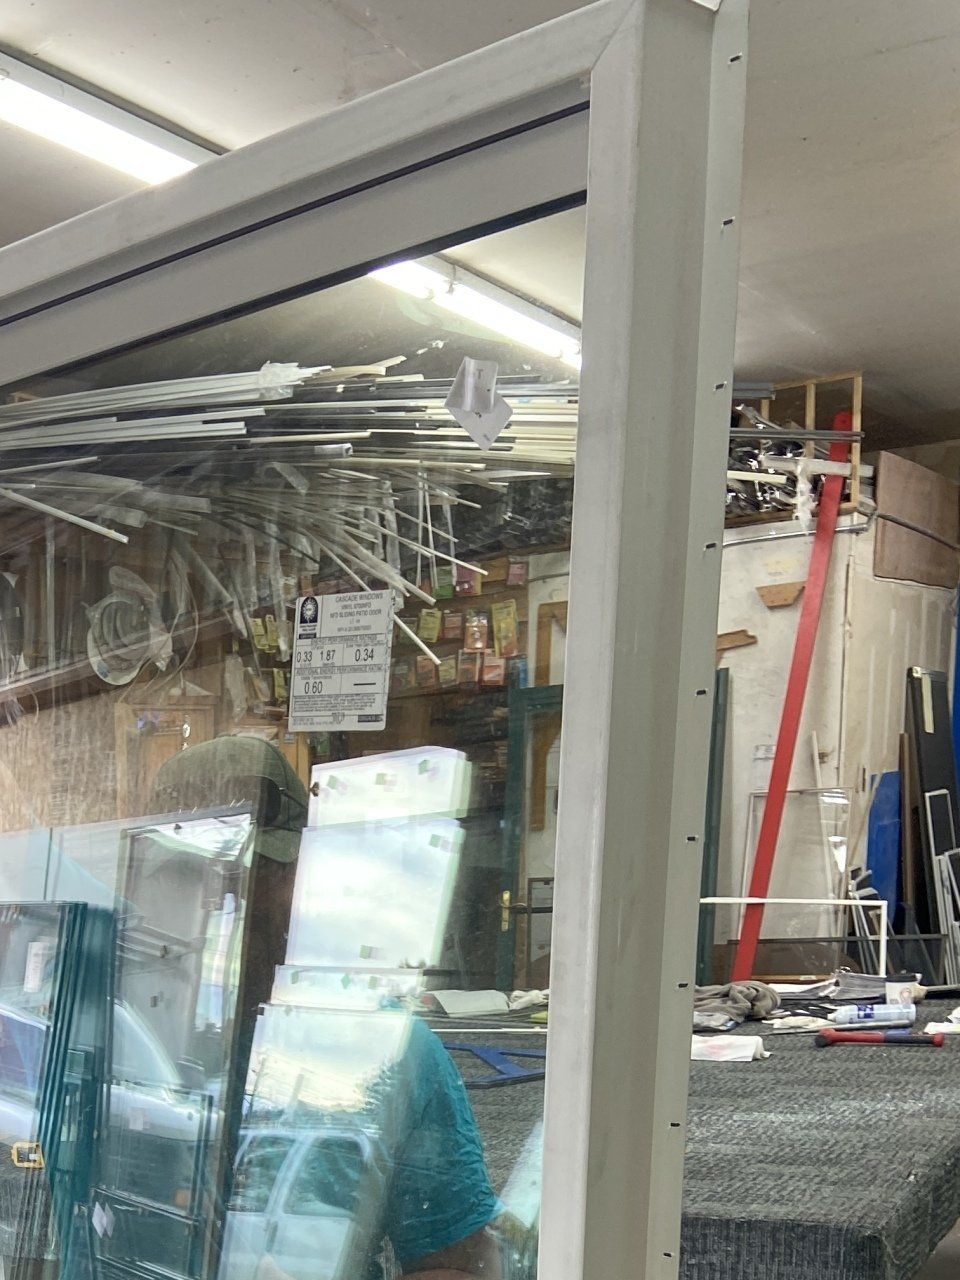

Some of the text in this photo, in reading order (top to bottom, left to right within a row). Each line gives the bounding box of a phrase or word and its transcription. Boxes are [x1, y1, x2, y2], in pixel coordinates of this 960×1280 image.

[296, 649, 336, 663] 0.33 1.87
[354, 648, 375, 662] 0.34
[304, 681, 323, 694] 0.60
